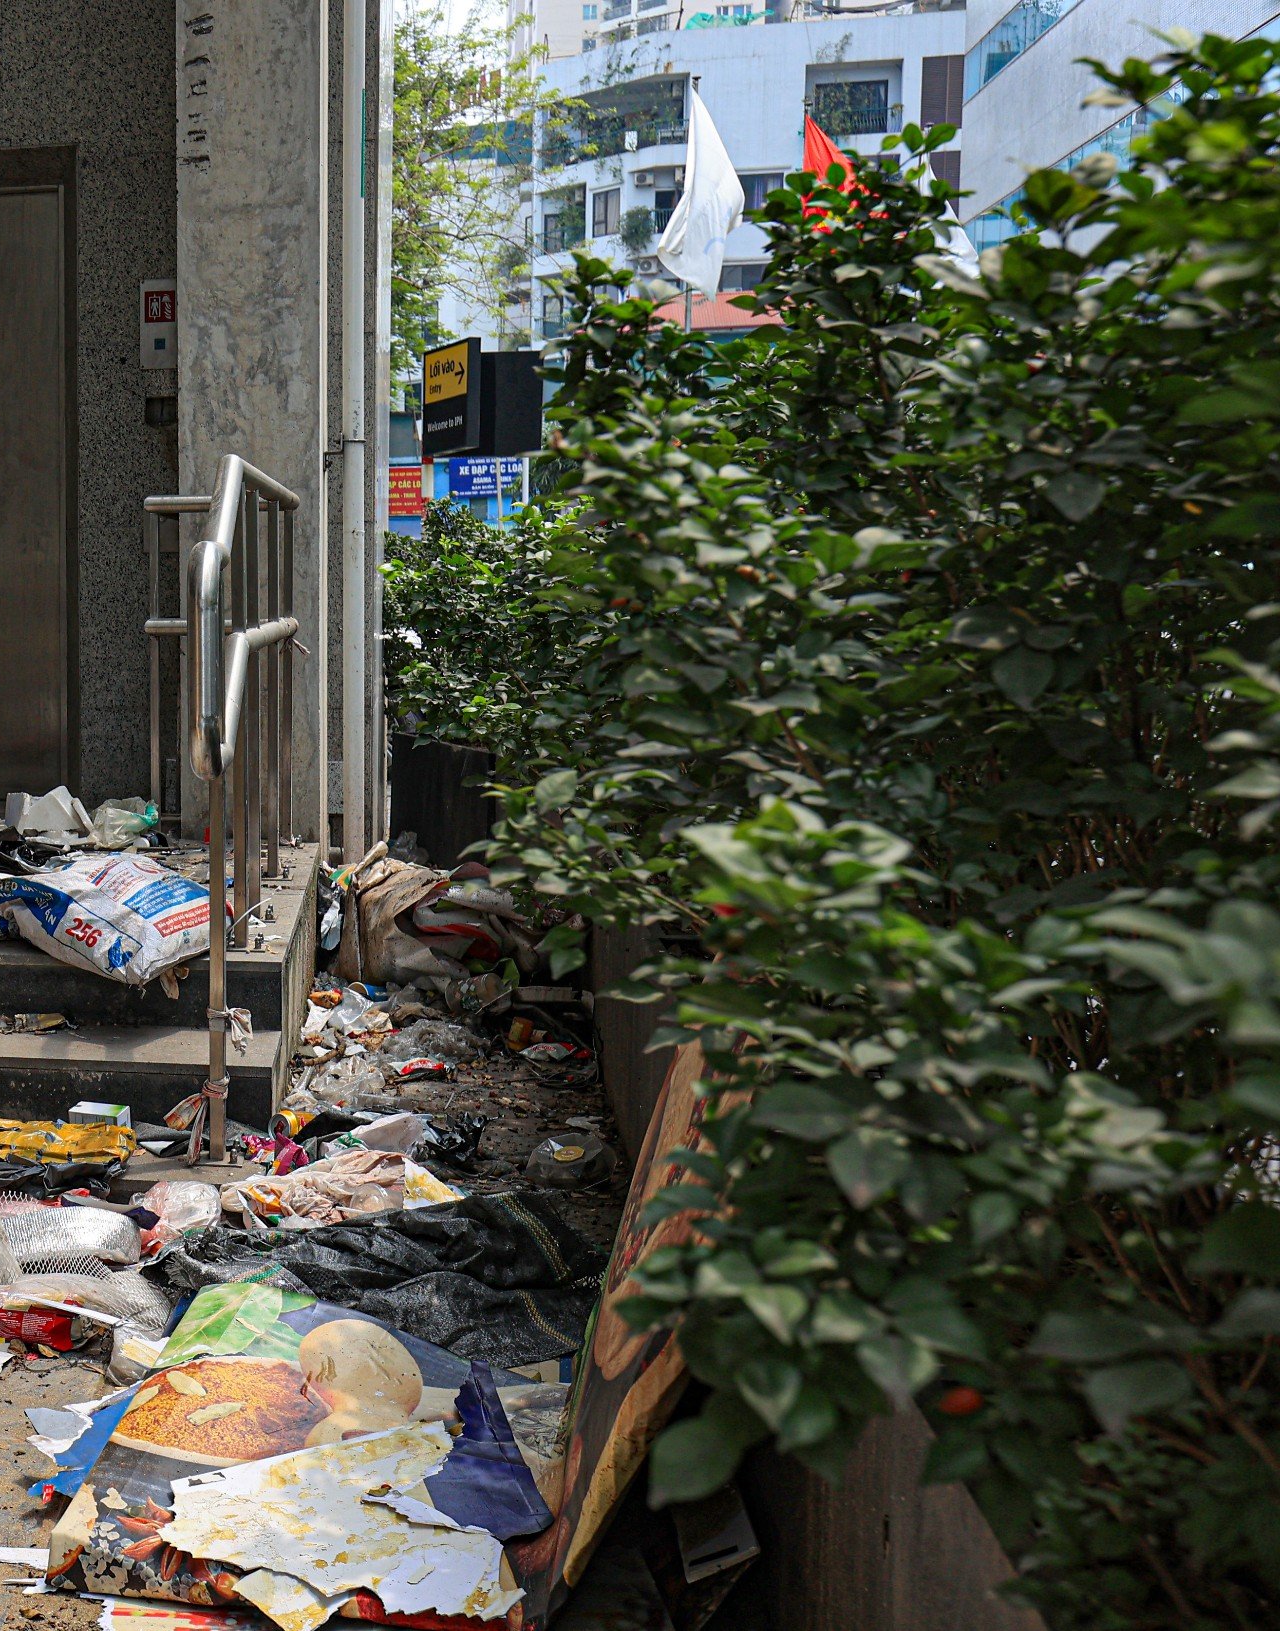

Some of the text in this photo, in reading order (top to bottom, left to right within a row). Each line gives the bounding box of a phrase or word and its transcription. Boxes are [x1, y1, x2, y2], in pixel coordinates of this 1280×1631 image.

[442, 359, 455, 374] vào
[430, 384, 442, 394] Entry
[427, 420, 448, 433] Welcome
[448, 418, 454, 428] to
[459, 465, 470, 475] XE
[489, 463, 506, 474] CC
[65, 917, 103, 948] 256
